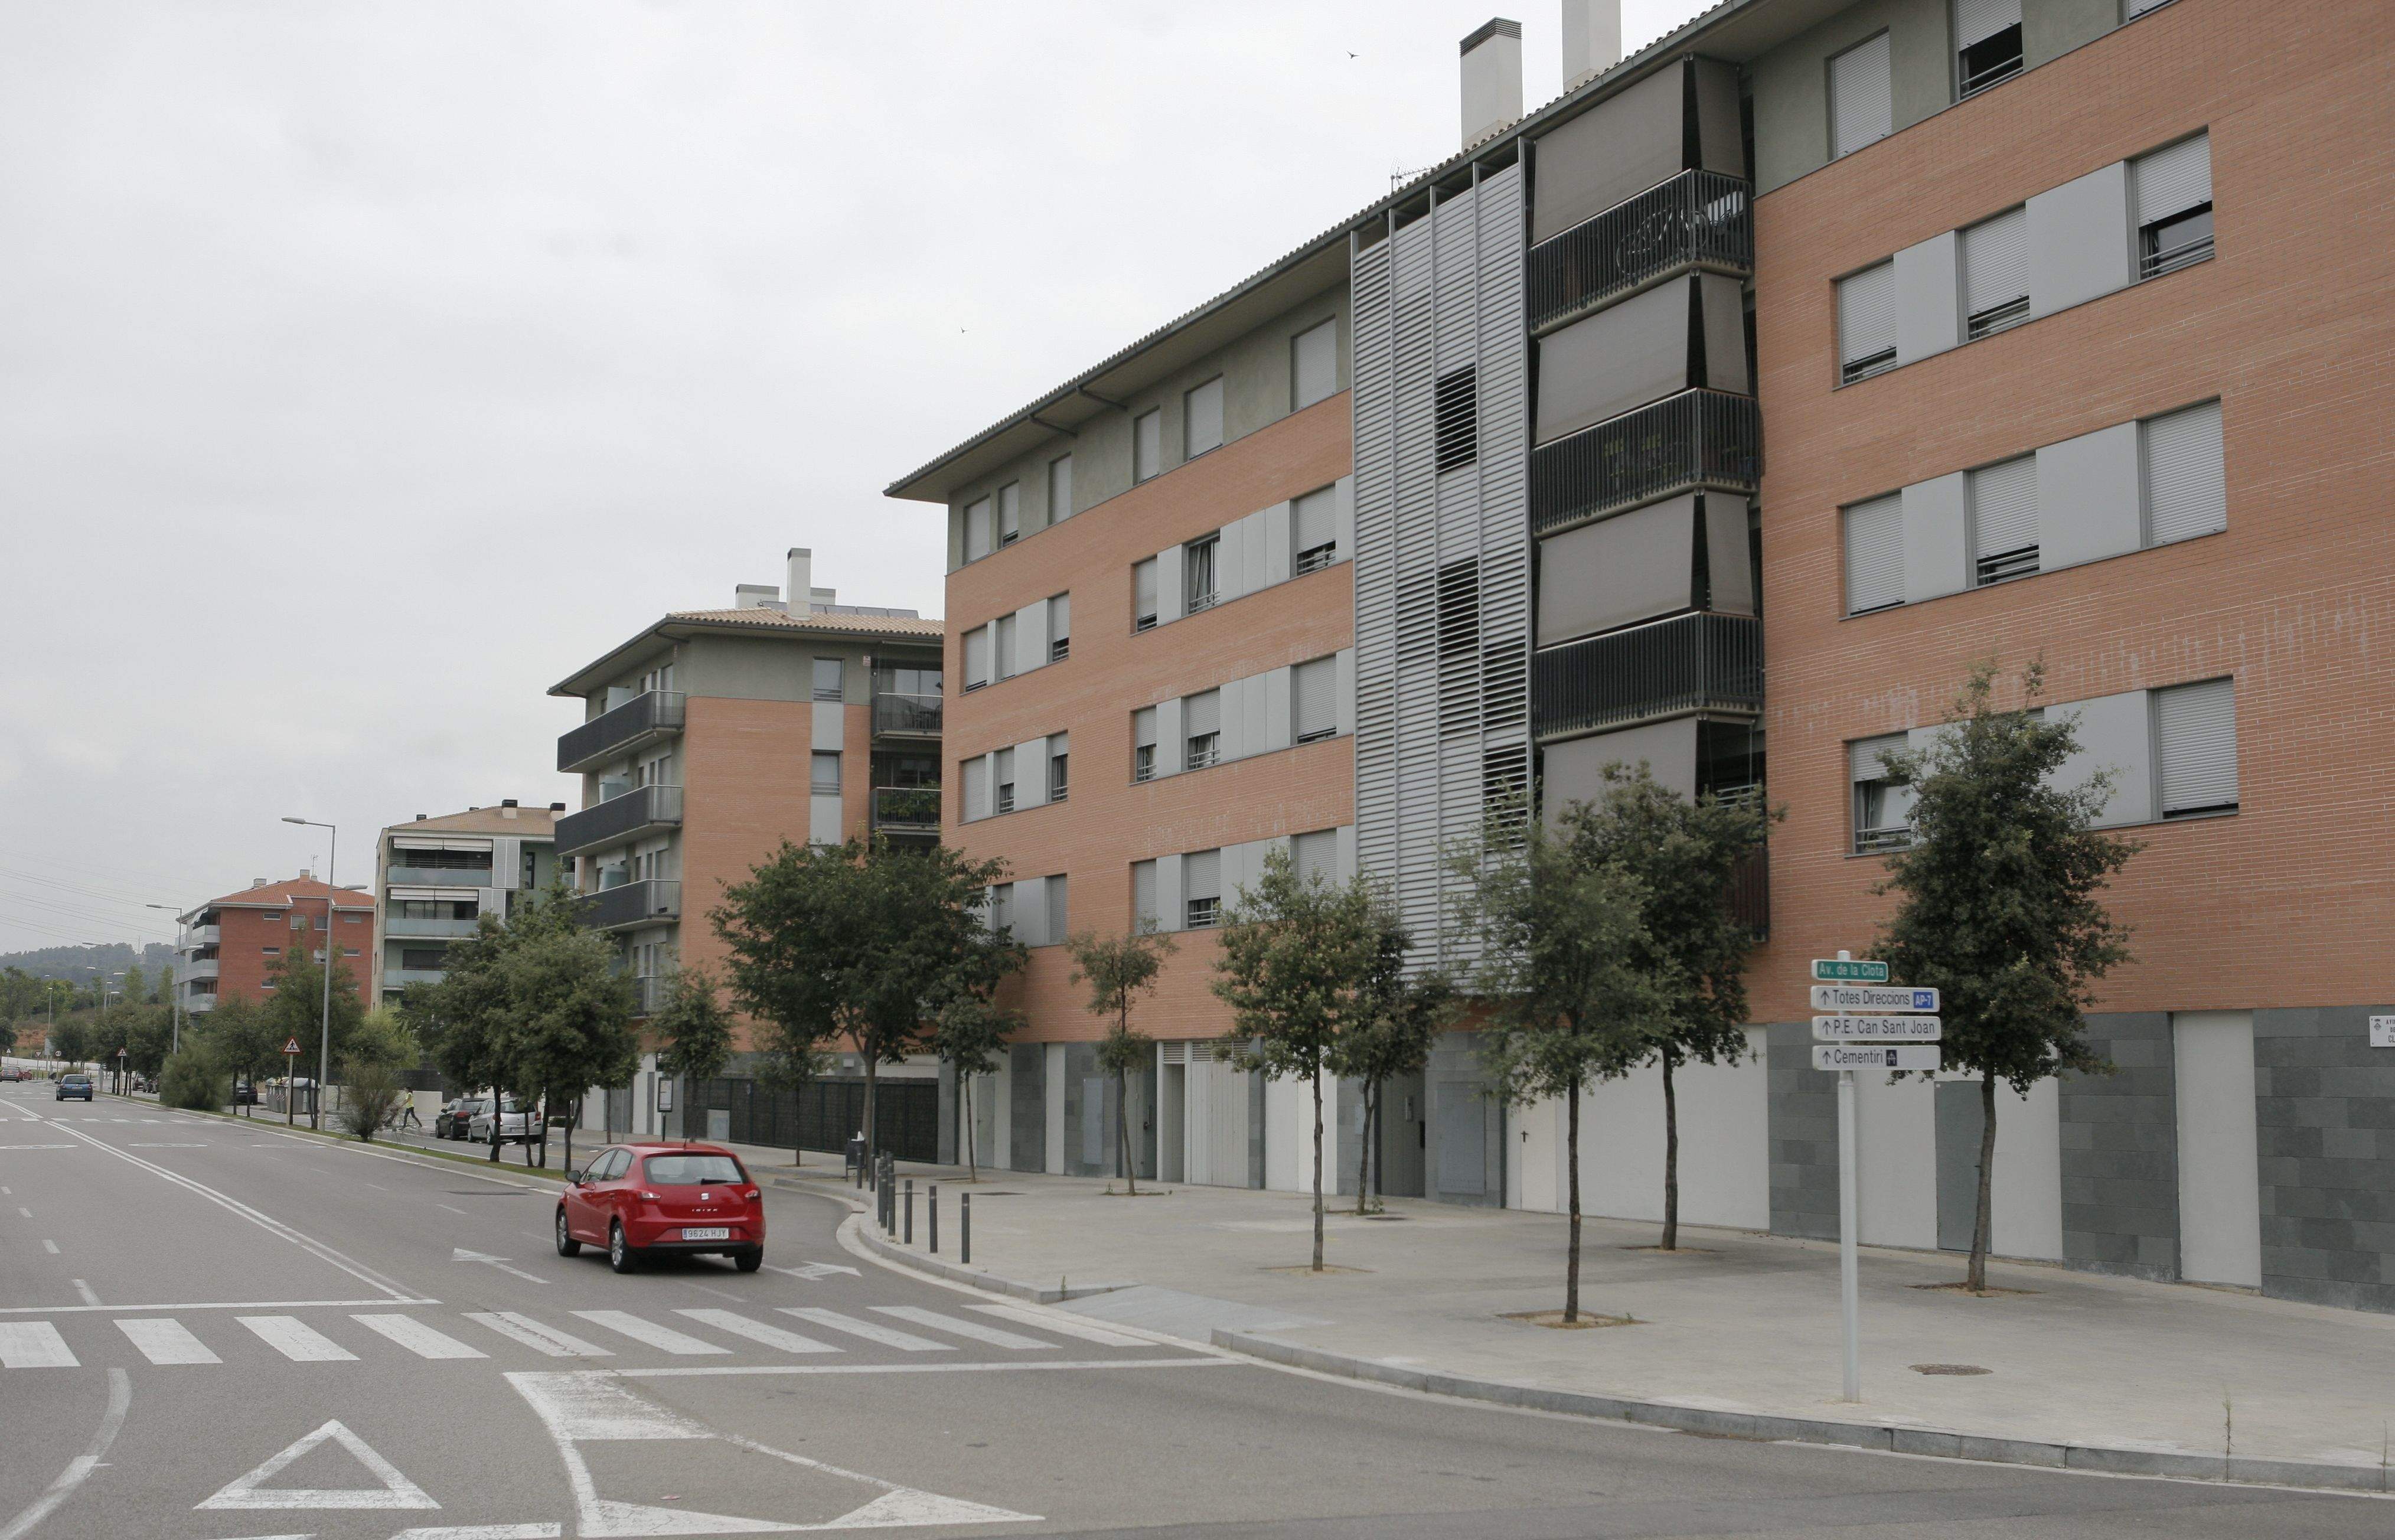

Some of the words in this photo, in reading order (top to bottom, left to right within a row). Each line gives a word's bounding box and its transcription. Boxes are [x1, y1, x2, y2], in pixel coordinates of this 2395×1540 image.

[1819, 963, 1834, 974] Av.
[1837, 963, 1848, 975] de
[1850, 964, 1858, 975] la
[1862, 964, 1884, 977] Clota
[1833, 990, 1860, 1004] Totes
[1864, 990, 1910, 1005] Direccions
[1915, 995, 1931, 1006] AP-7
[1833, 1020, 1853, 1034] P.E.
[1858, 1020, 1878, 1034] Can
[1882, 1020, 1907, 1034] Sant
[1911, 1020, 1935, 1034] Joan
[1834, 1049, 1883, 1064] Cementiri
[688, 1229, 709, 1238] 9624
[711, 1229, 726, 1237] HJY
